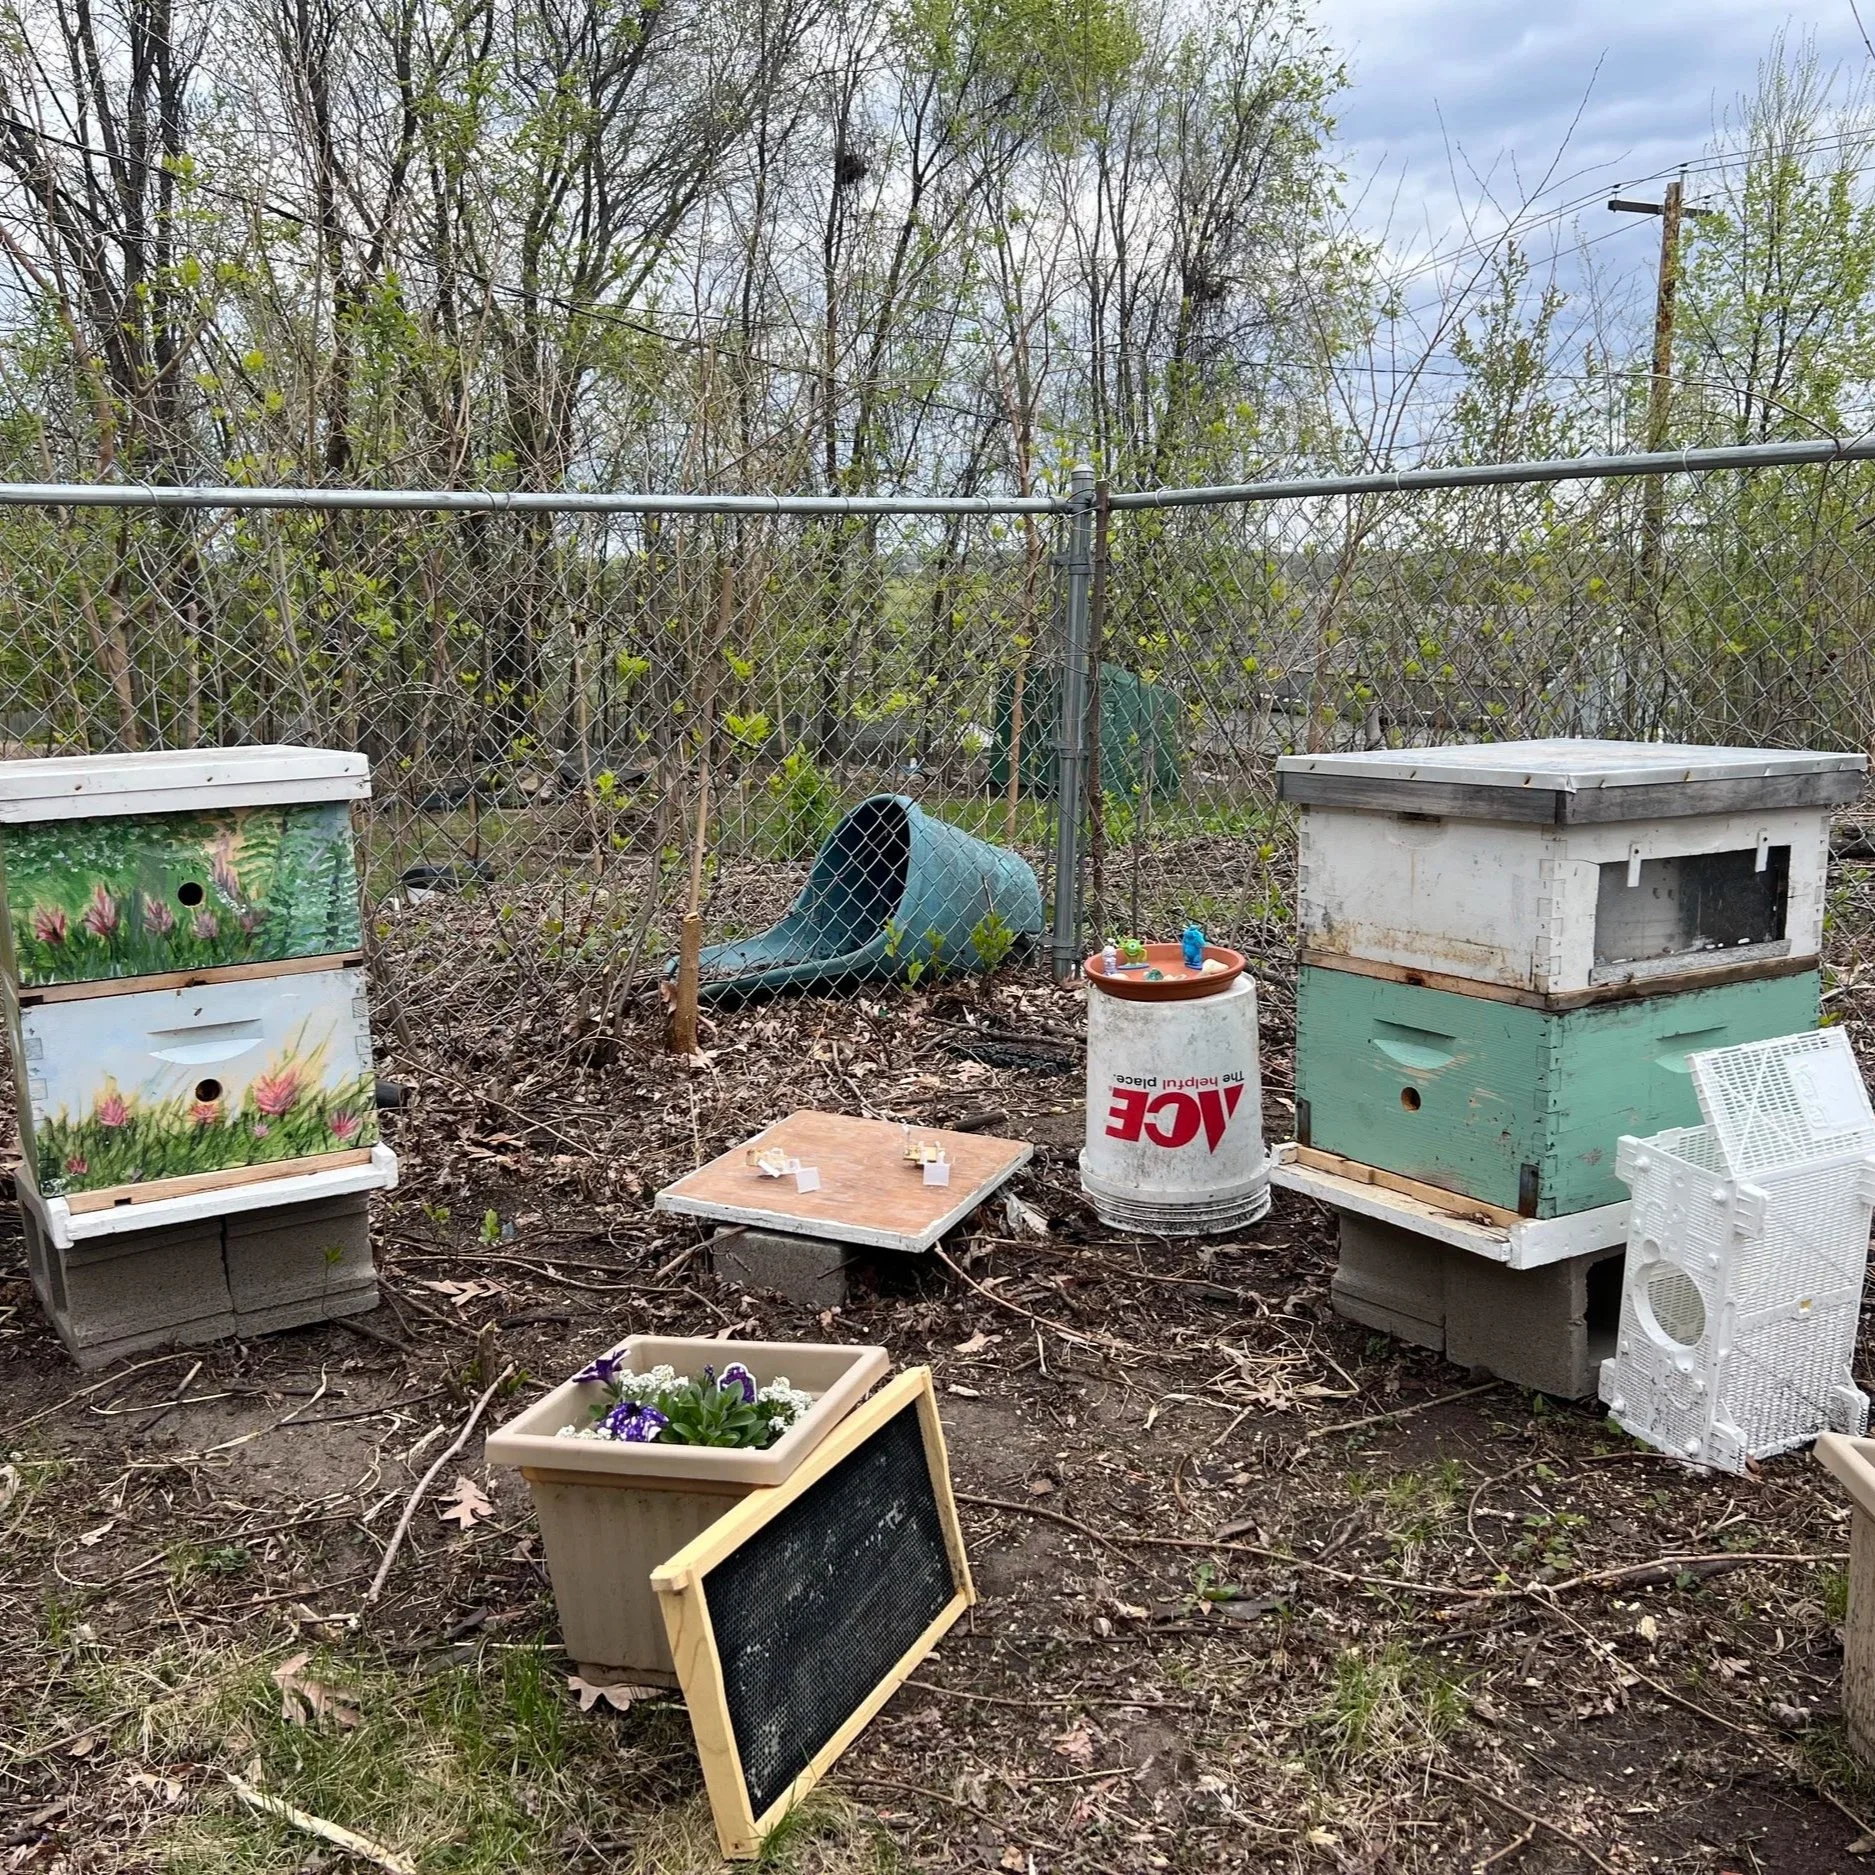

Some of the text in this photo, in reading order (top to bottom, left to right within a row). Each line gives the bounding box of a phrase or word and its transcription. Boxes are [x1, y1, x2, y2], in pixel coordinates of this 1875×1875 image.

[1113, 1070, 1245, 1090] The helpful place.
[1105, 1083, 1245, 1154] ACE
